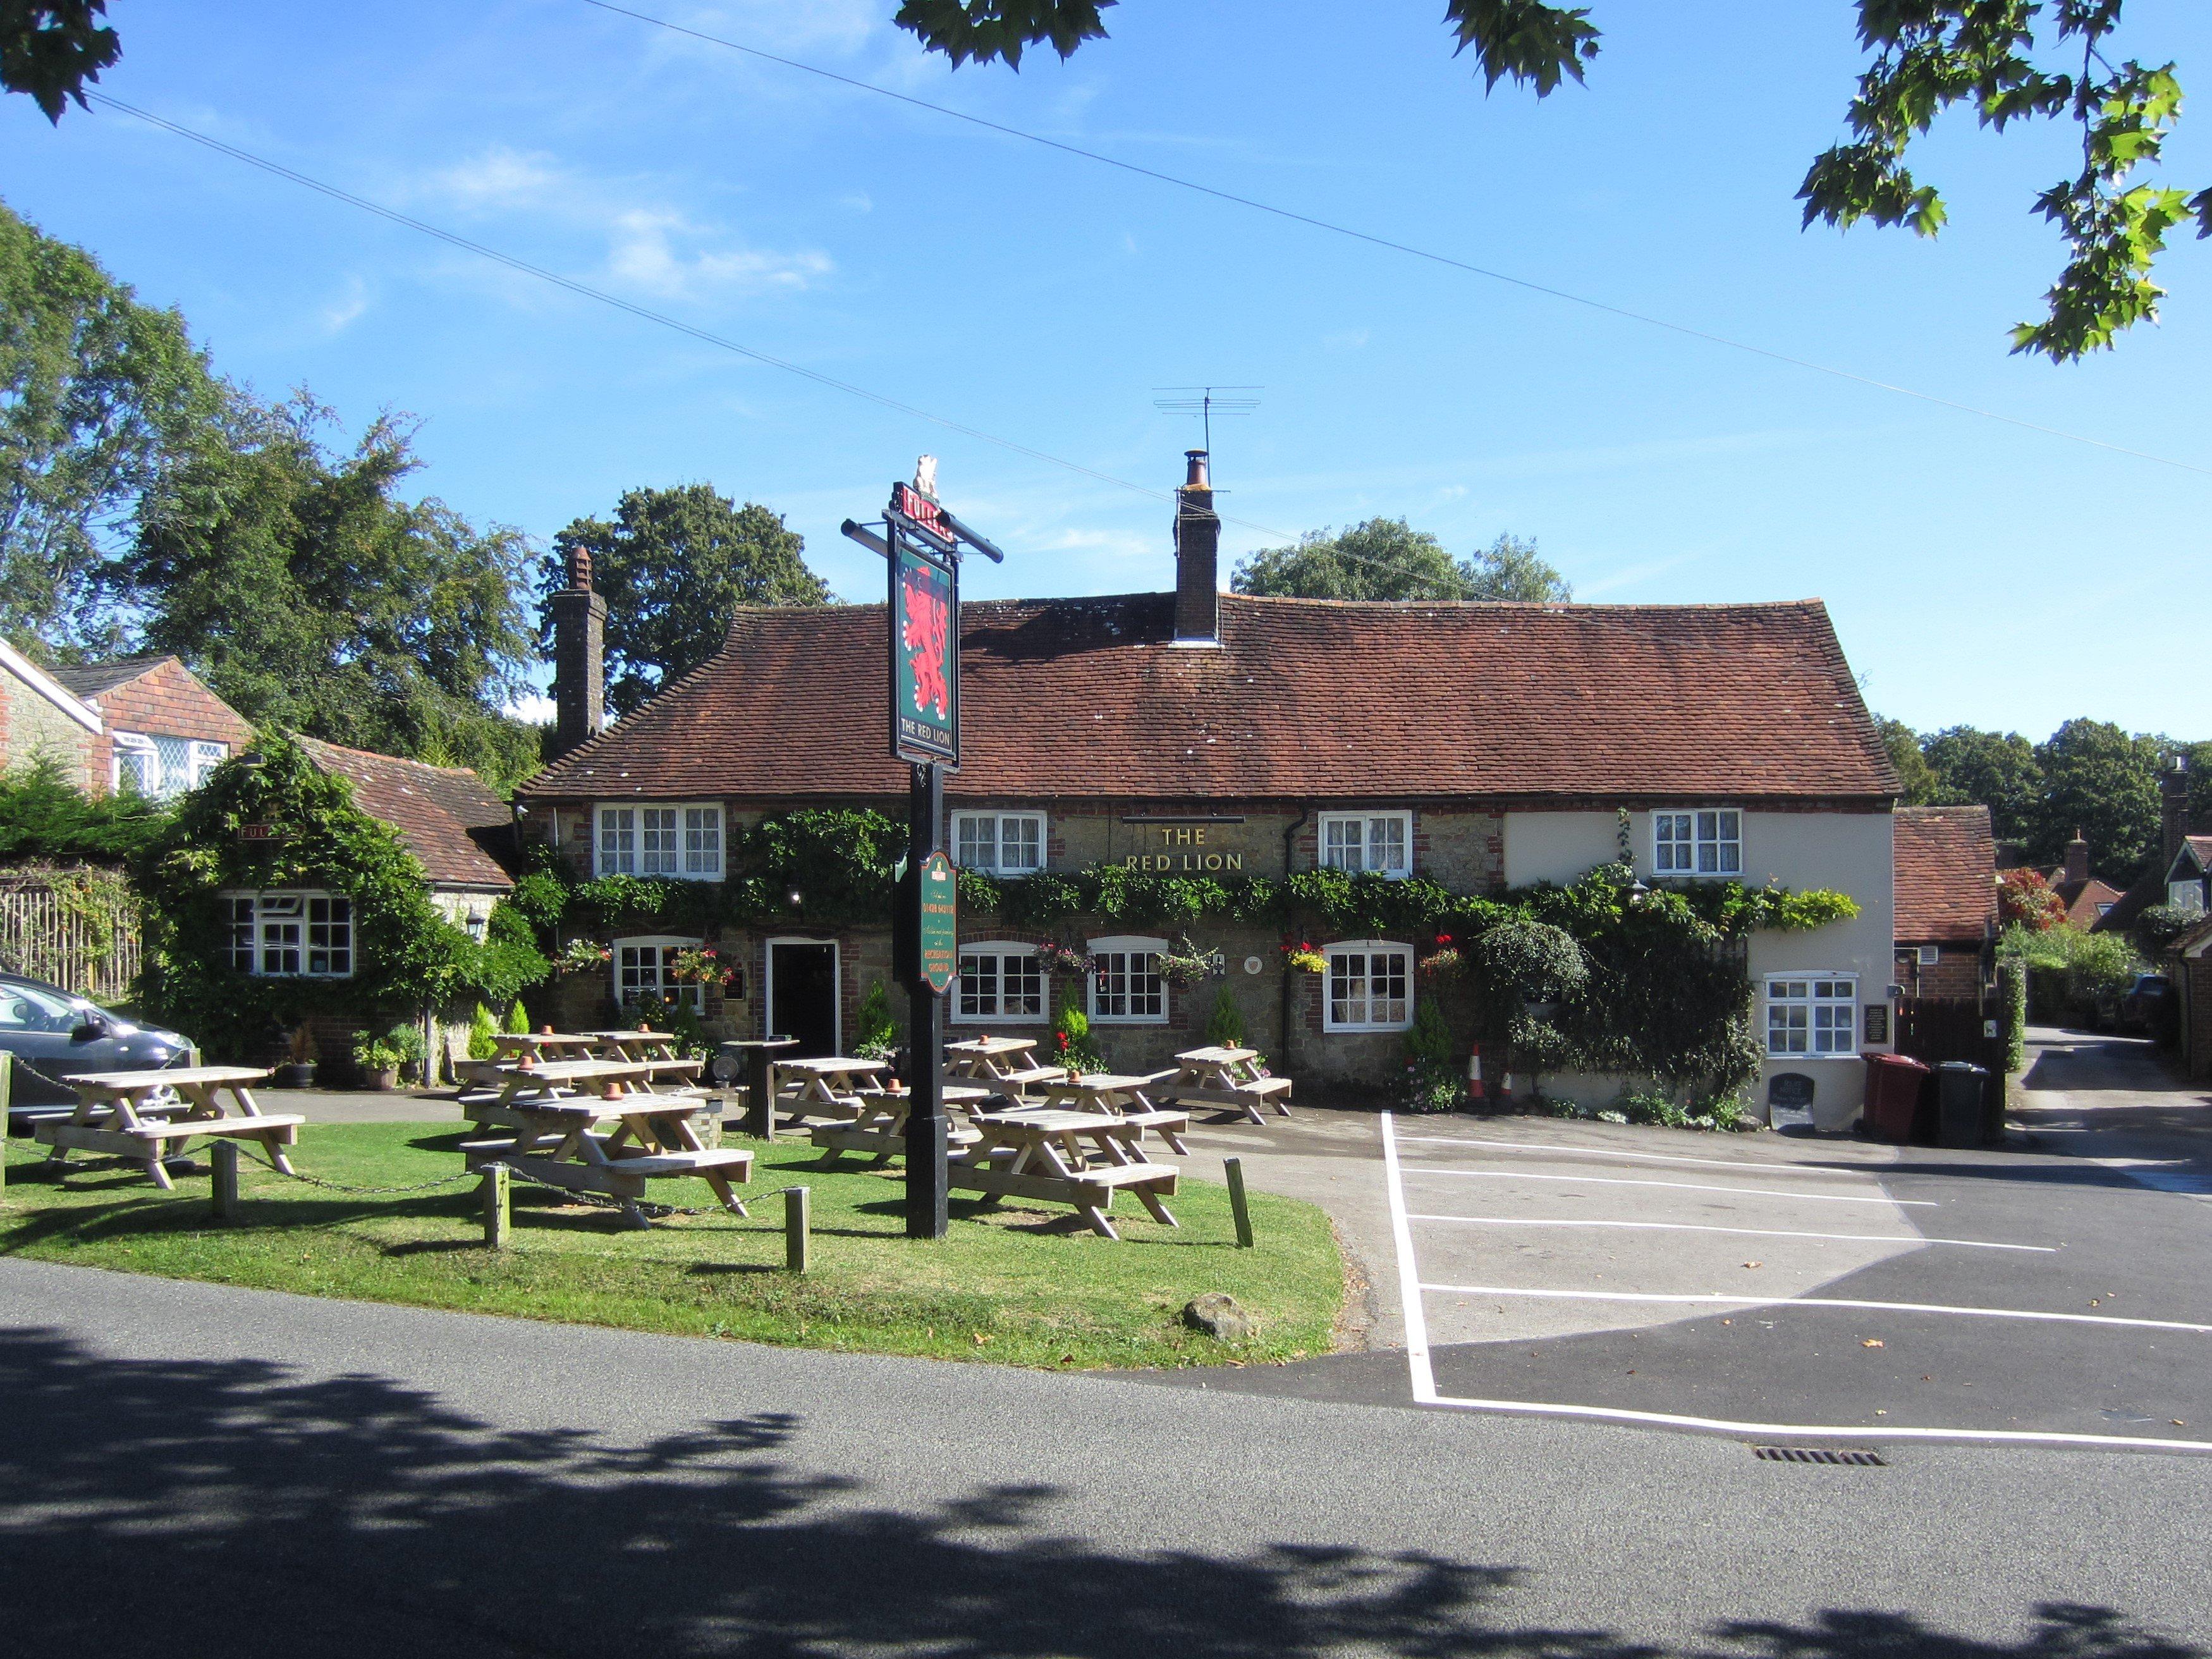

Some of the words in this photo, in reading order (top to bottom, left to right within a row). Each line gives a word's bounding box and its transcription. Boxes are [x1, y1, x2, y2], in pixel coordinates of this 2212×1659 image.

[901, 718, 915, 735] THE
[918, 724, 931, 739] RED
[933, 729, 950, 745] LION
[1162, 828, 1205, 845] THE
[1125, 854, 1171, 872] RED
[1183, 854, 1242, 871] LION
